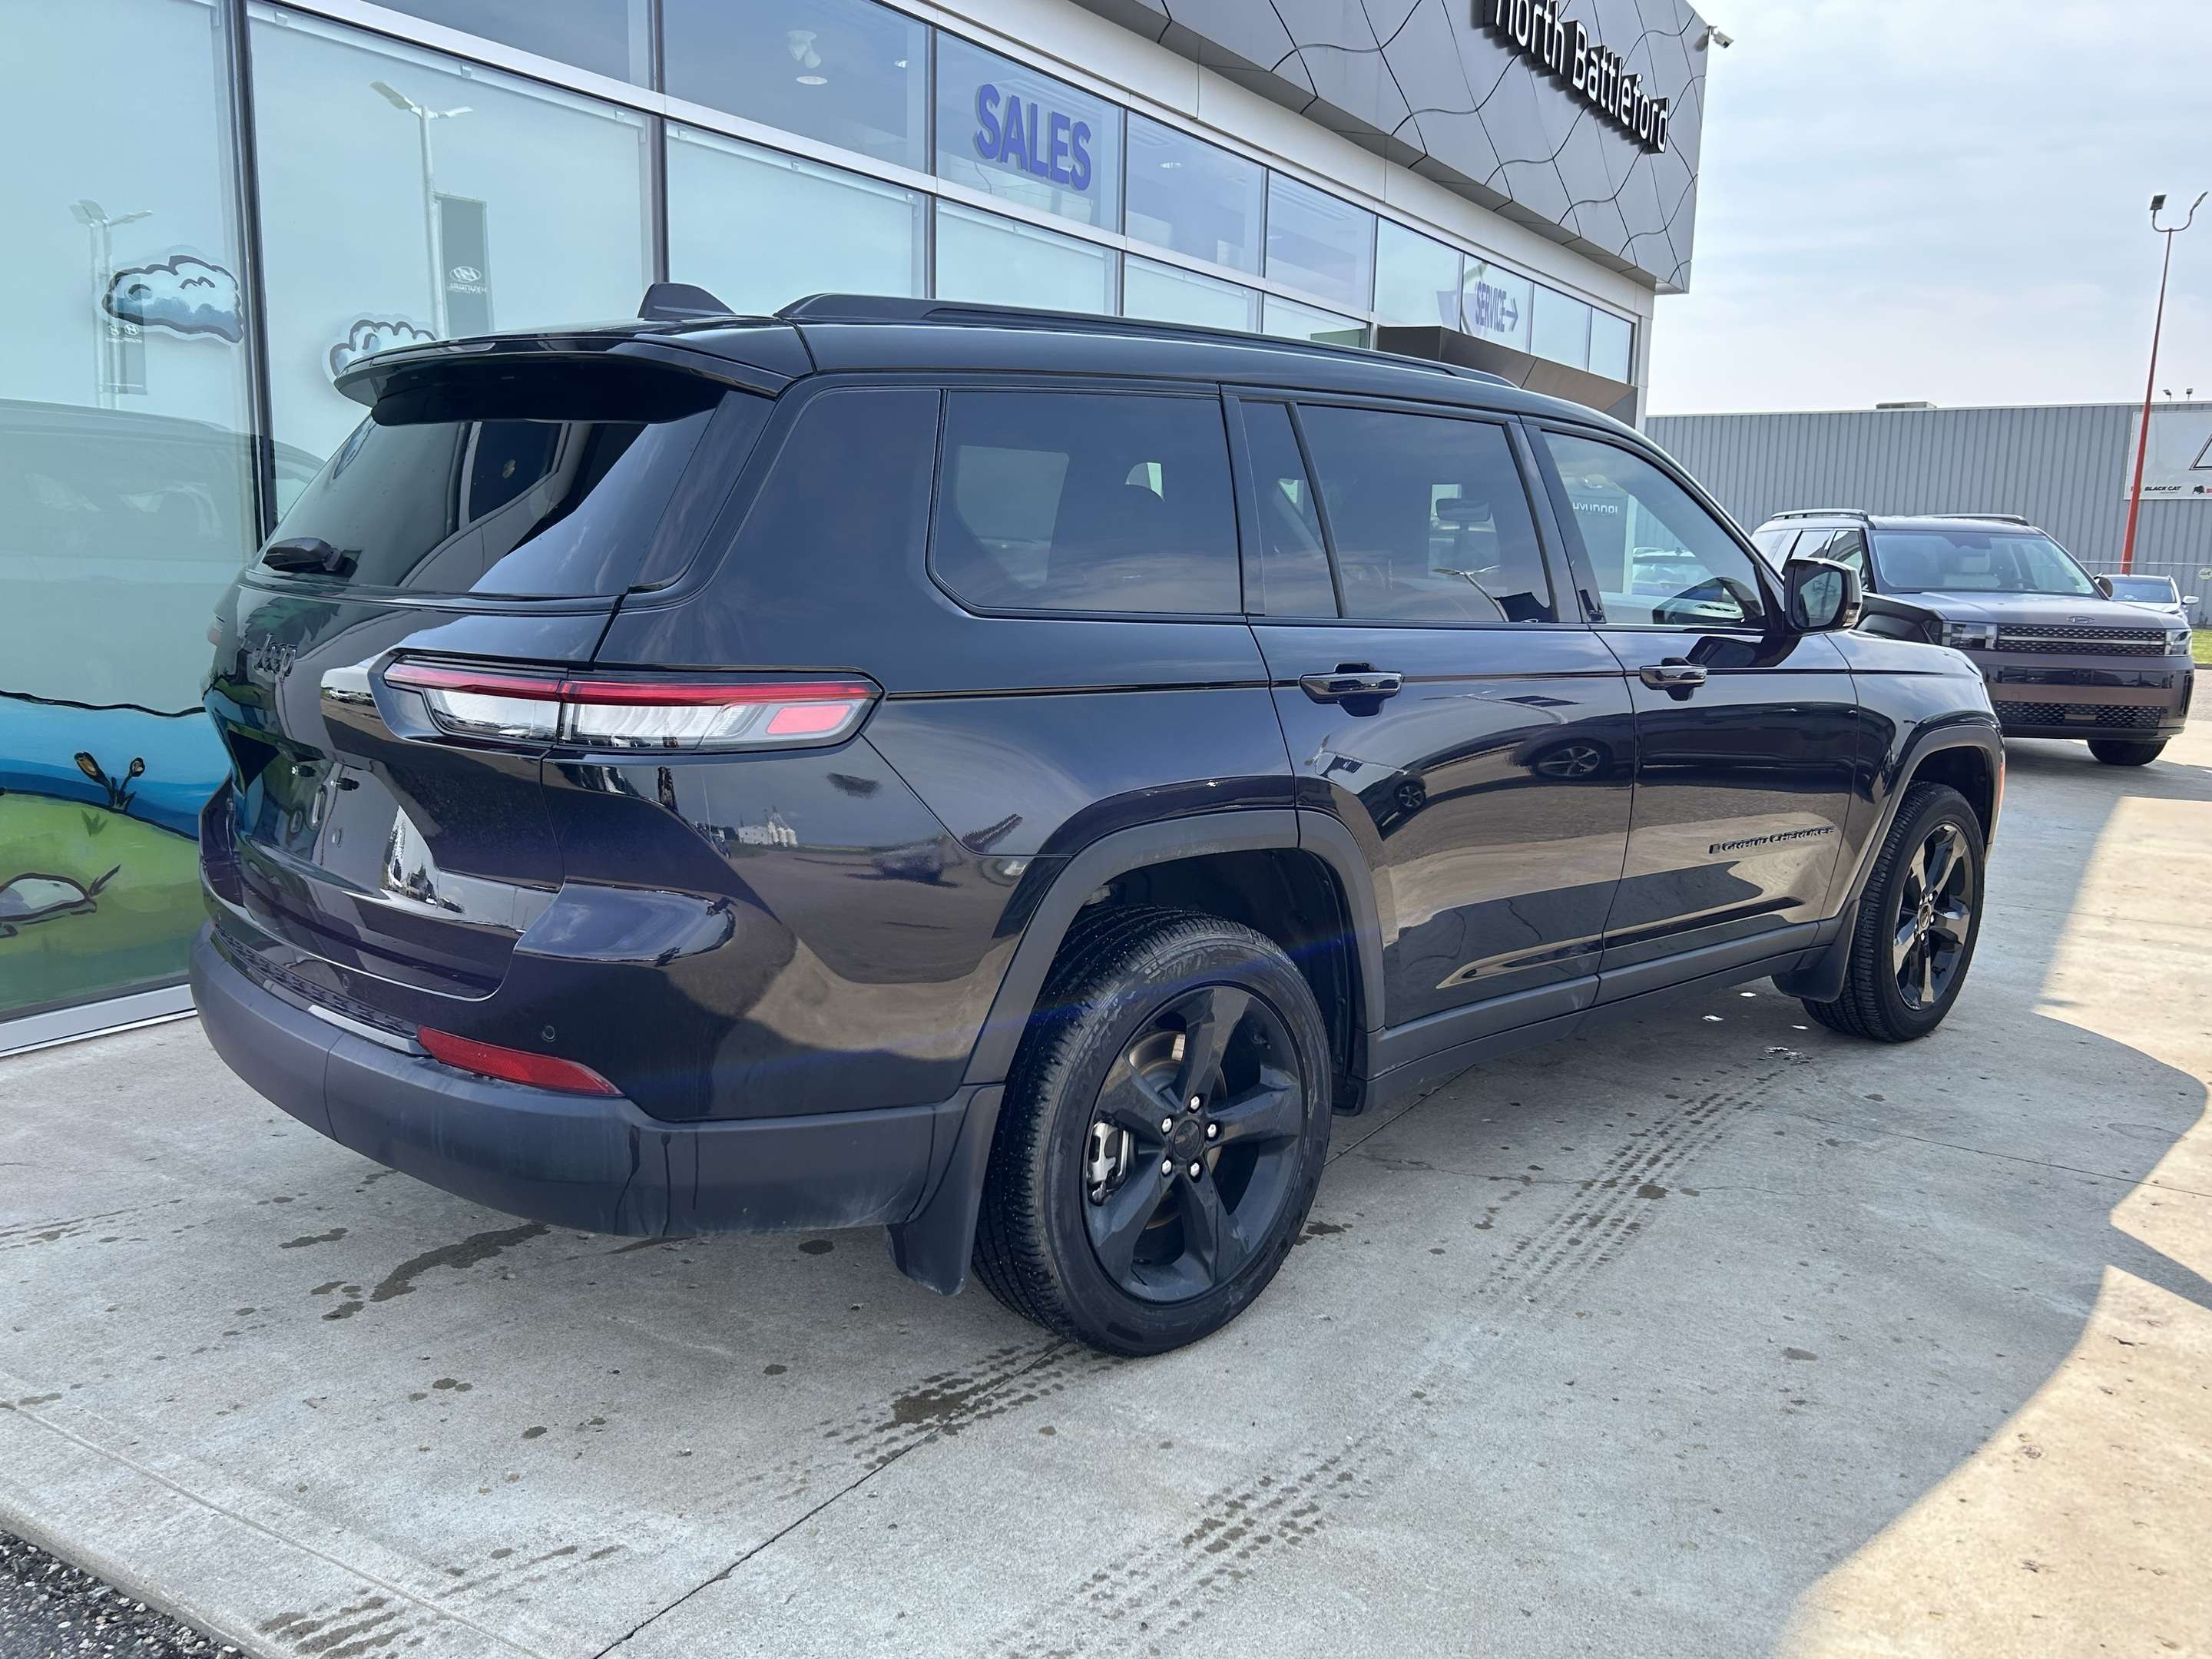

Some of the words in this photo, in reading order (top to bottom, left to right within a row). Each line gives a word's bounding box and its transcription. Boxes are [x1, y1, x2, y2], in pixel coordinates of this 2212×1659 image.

[973, 83, 1092, 191] SALES
[1571, 19, 1670, 153] Battleford
[1475, 280, 1507, 333] SERVICE
